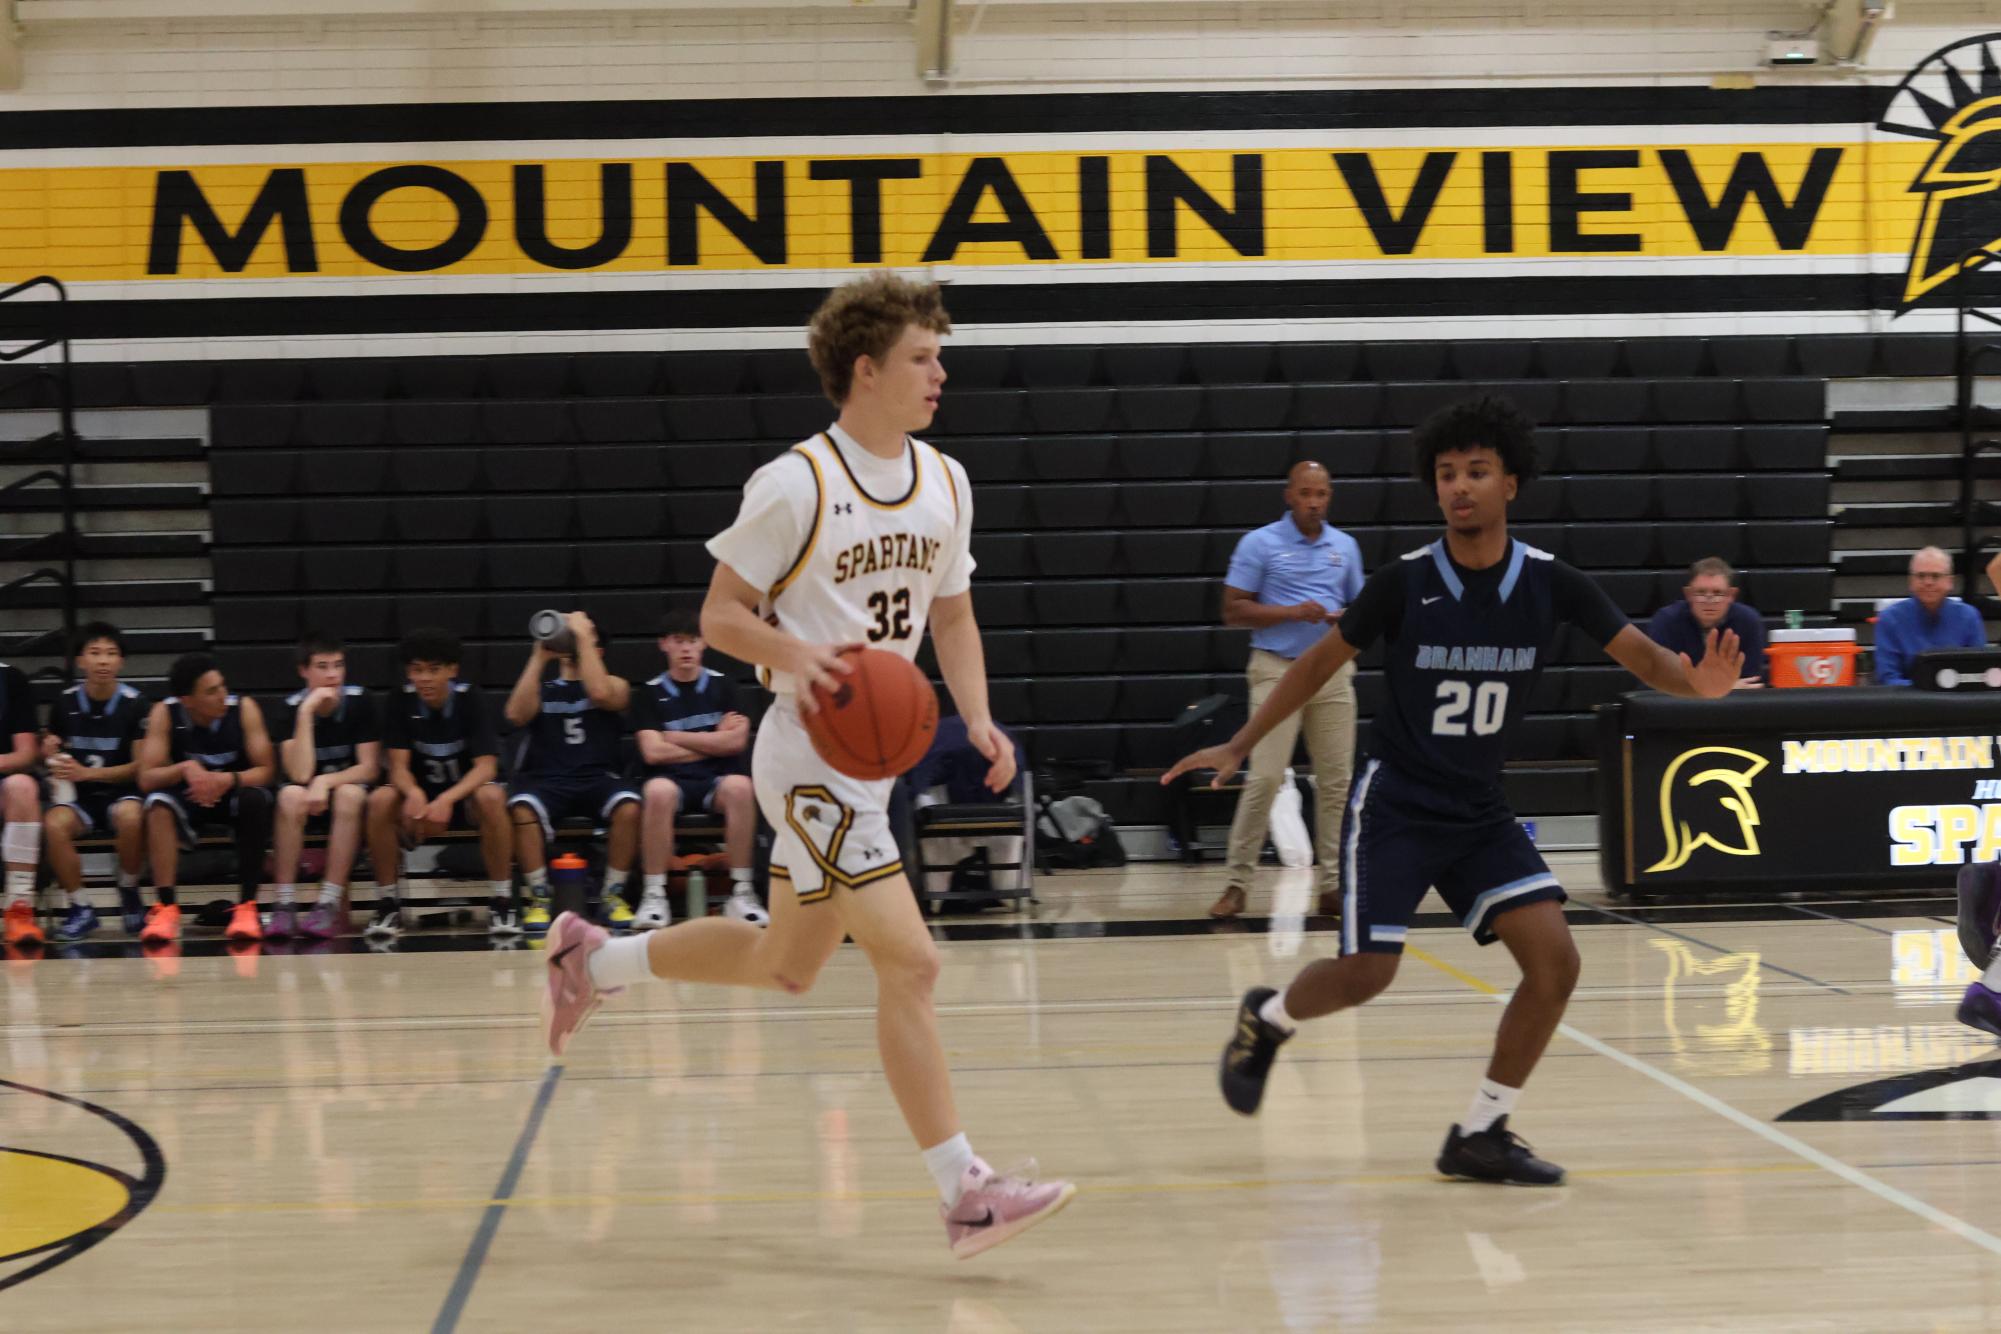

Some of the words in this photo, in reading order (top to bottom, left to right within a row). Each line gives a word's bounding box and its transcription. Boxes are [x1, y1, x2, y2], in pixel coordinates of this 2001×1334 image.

[146, 152, 1266, 275] MOUNTAIN
[1331, 146, 1845, 256] VIEW
[866, 587, 912, 642] 32
[1415, 644, 1537, 672] BRANHAM
[1808, 659, 1835, 679] G
[1432, 679, 1509, 736] 20
[563, 717, 586, 745] 5
[1782, 735, 1994, 774] MOUNTAIN
